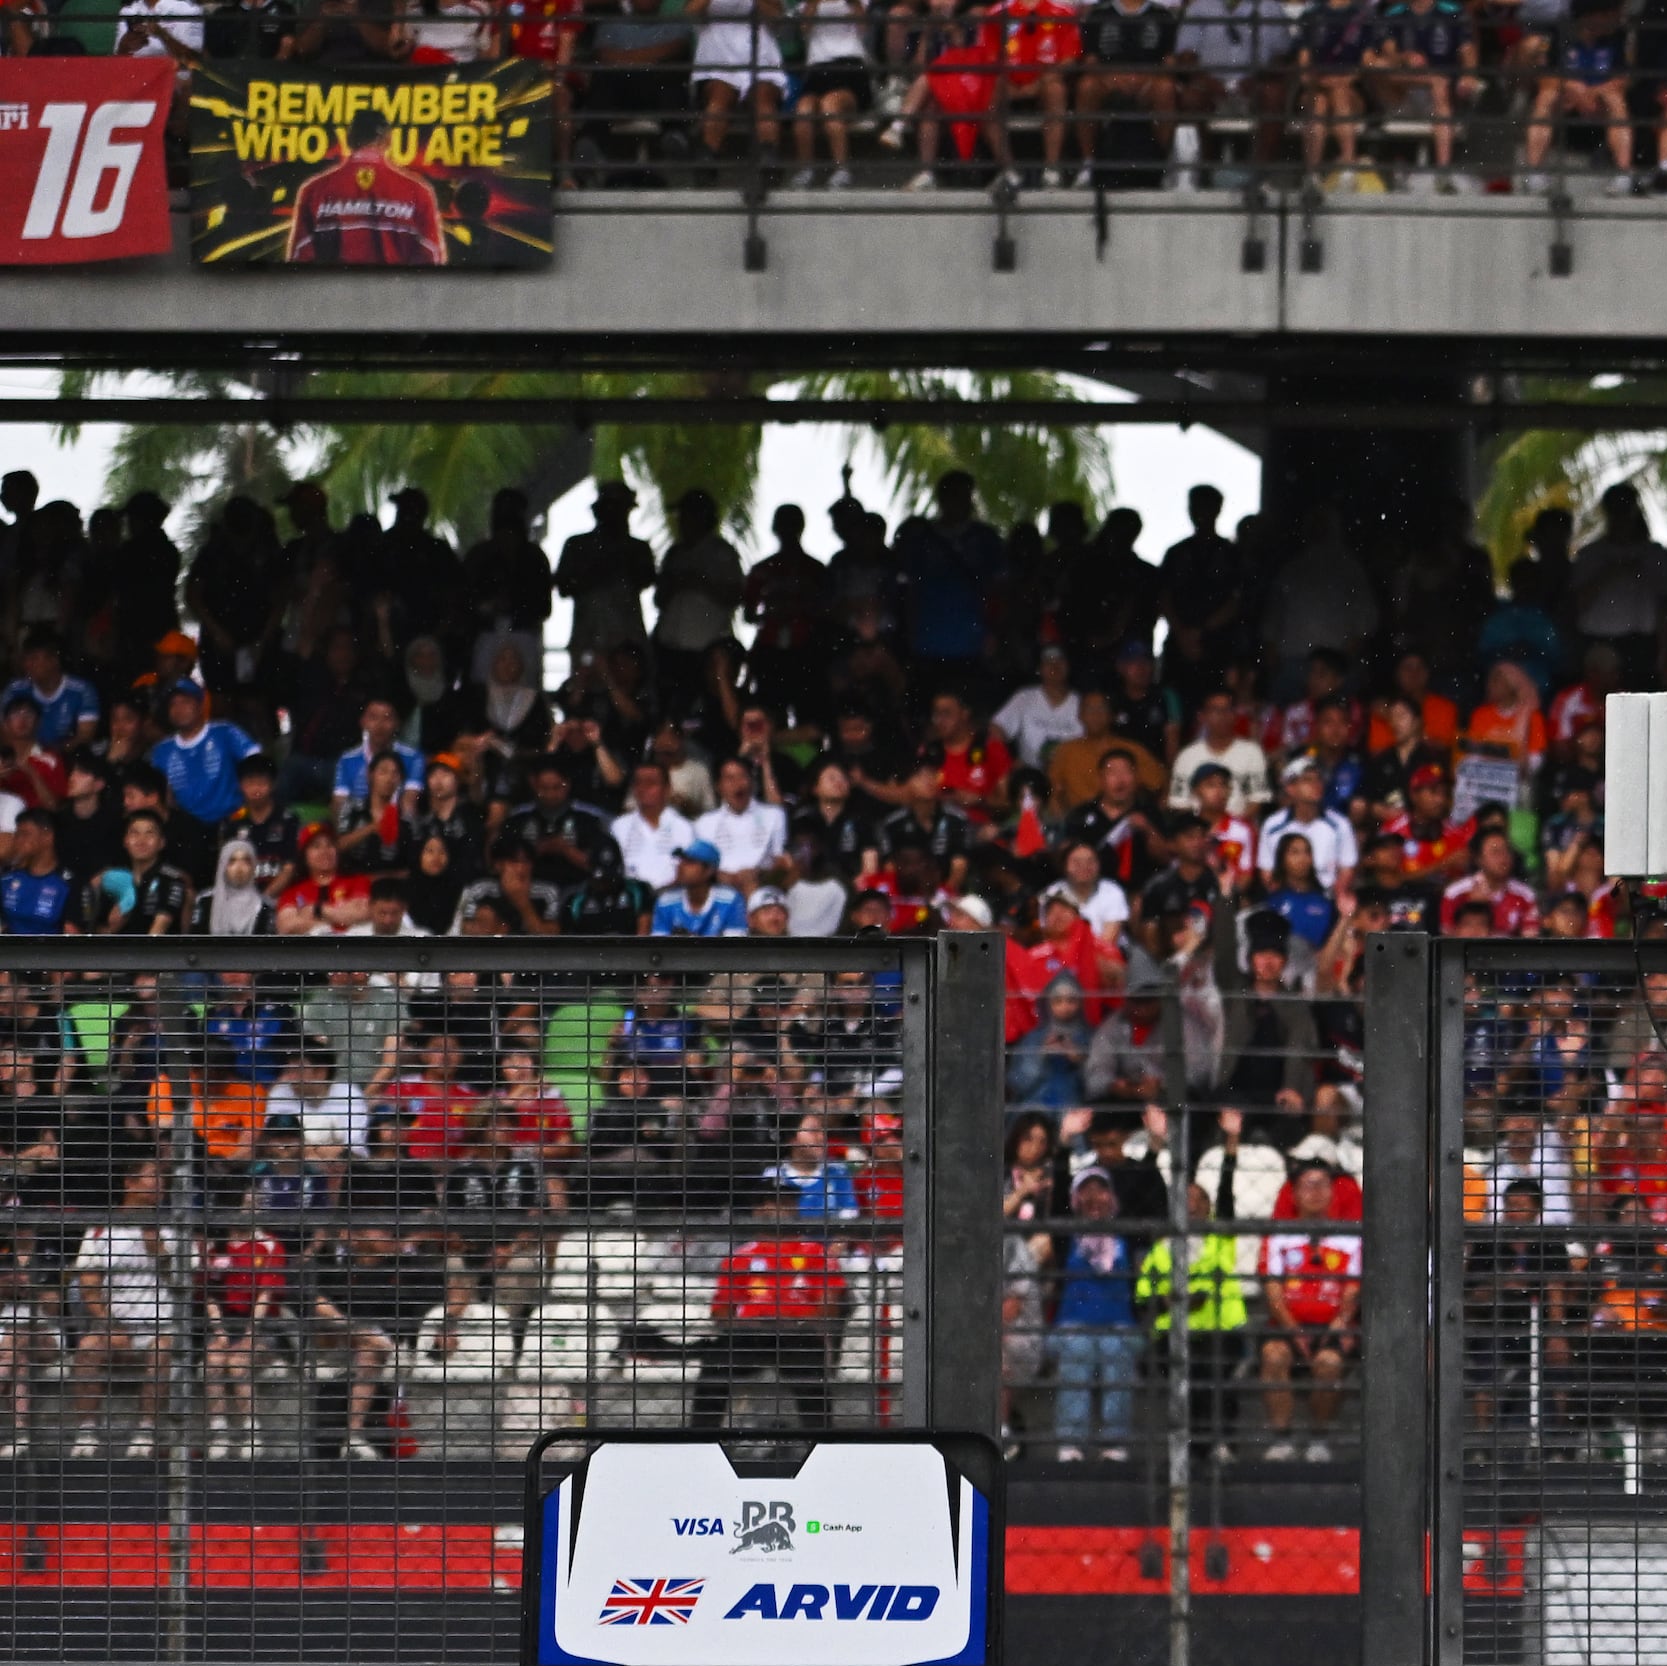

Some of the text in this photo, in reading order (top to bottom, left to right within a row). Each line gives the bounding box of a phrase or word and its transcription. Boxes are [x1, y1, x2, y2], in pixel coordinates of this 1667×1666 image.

[248, 81, 498, 125] REMEMBER
[232, 120, 328, 164] WHO
[423, 124, 504, 166] ARE
[22, 102, 157, 239] 16
[316, 200, 416, 220] HAMILTON
[670, 1518, 724, 1536] VISA
[823, 1523, 862, 1532] Cash App
[722, 1583, 940, 1621] ARVID
